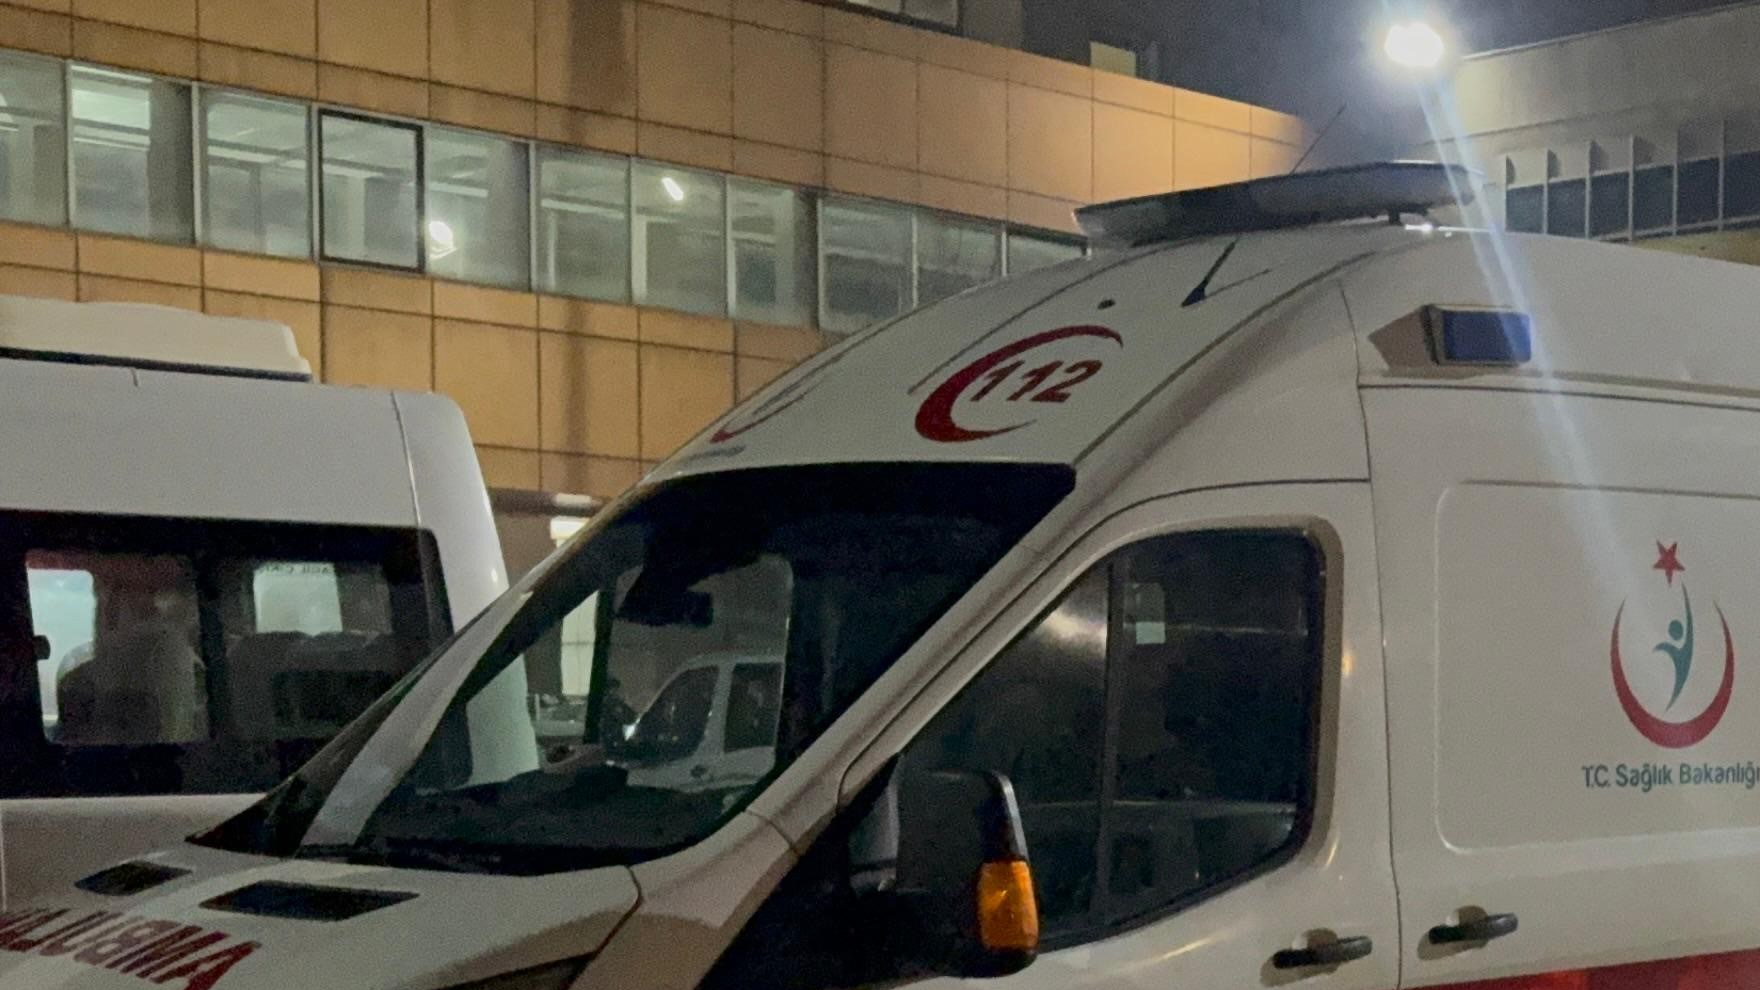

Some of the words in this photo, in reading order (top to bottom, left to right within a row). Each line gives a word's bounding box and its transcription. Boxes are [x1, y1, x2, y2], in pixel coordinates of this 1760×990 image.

[970, 359, 1103, 403] 112
[1615, 762, 1673, 793] Sağlık
[1679, 761, 1760, 790] Bakanlığı
